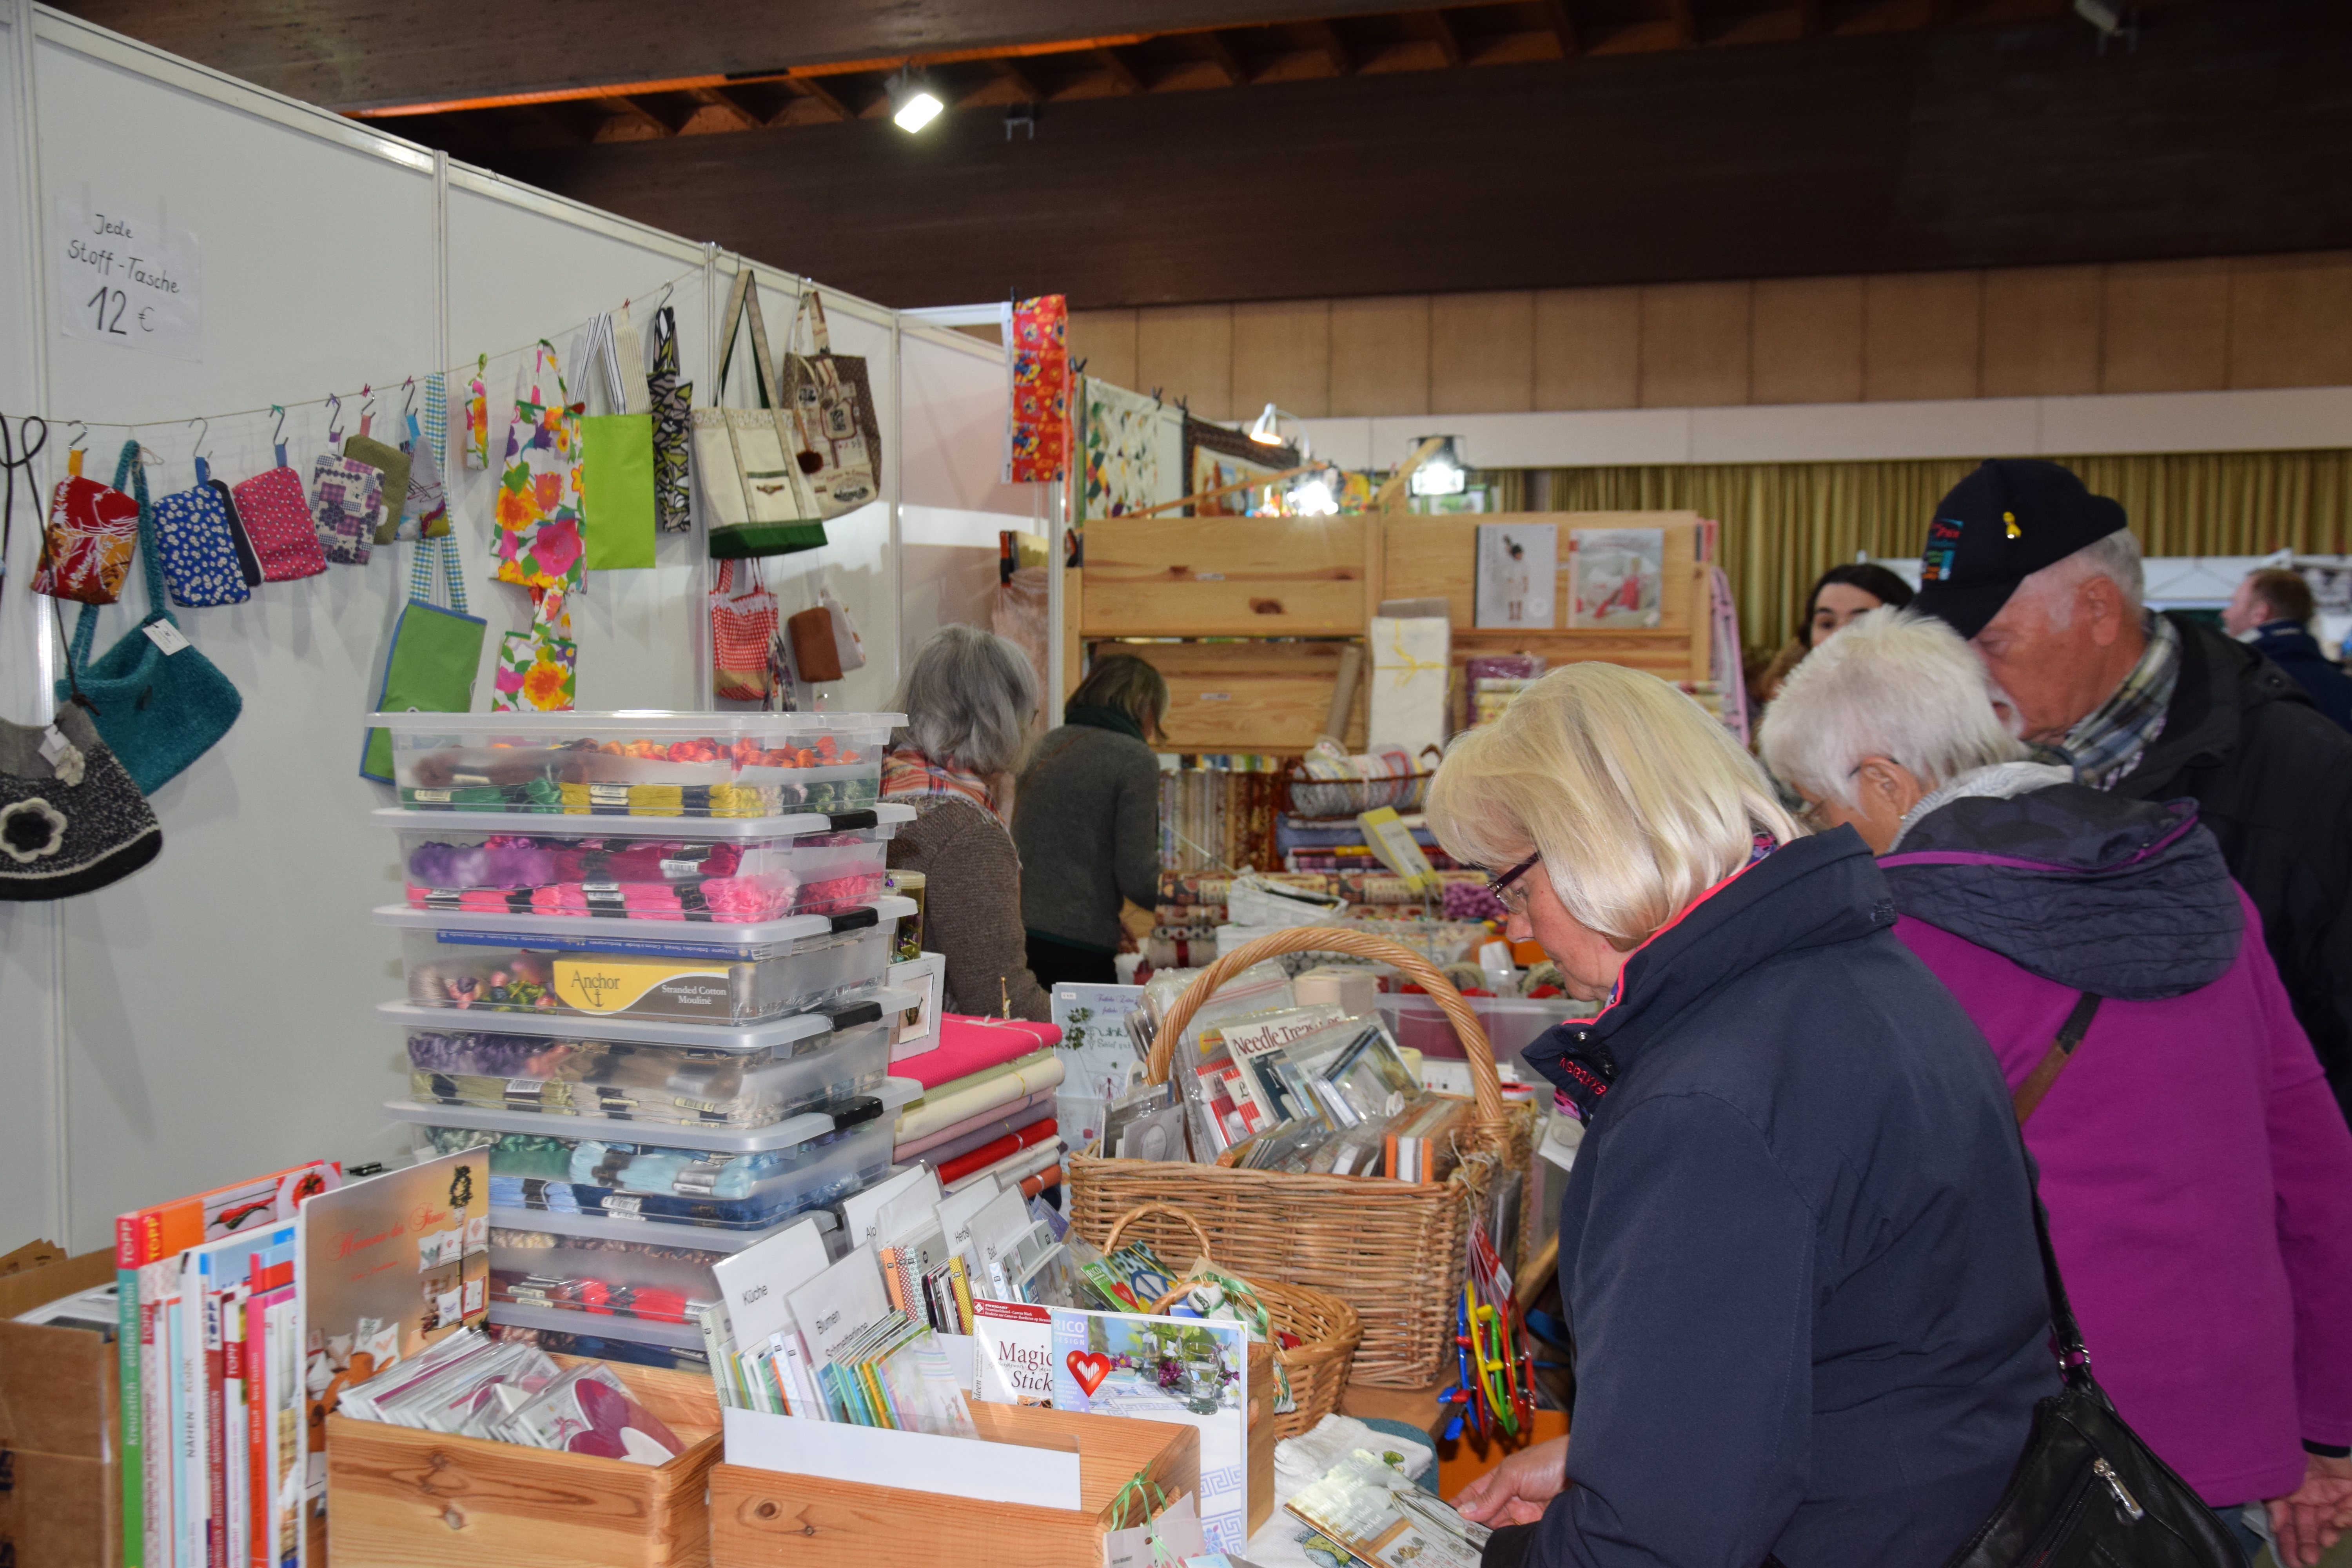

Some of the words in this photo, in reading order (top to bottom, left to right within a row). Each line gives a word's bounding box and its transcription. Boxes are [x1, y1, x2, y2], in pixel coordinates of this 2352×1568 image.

[93, 213, 134, 239] Jede
[87, 286, 128, 336] 12
[138, 306, 154, 332] €
[571, 969, 621, 991] Anchor
[661, 985, 697, 995] Stranded
[699, 986, 726, 996] Cotton
[678, 995, 711, 1005] Mouliné
[1232, 1025, 1279, 1056] Needle
[121, 1221, 134, 1264] TOPP
[147, 1217, 161, 1261] TOPP
[987, 1243, 997, 1260] Bad
[1086, 1266, 1102, 1278] RICO
[124, 1283, 135, 1318] schön
[742, 1285, 768, 1306] Küche
[1027, 1285, 1038, 1301] RICO
[141, 1306, 152, 1340] TOPP
[206, 1301, 218, 1345] TOPP
[816, 1310, 841, 1335] Blumen
[125, 1322, 137, 1367] einfach
[998, 1341, 1052, 1371] Magic
[1054, 1336, 1085, 1346] DESIGN
[226, 1343, 237, 1376] TOPP
[125, 1382, 138, 1446] Kreuzstich
